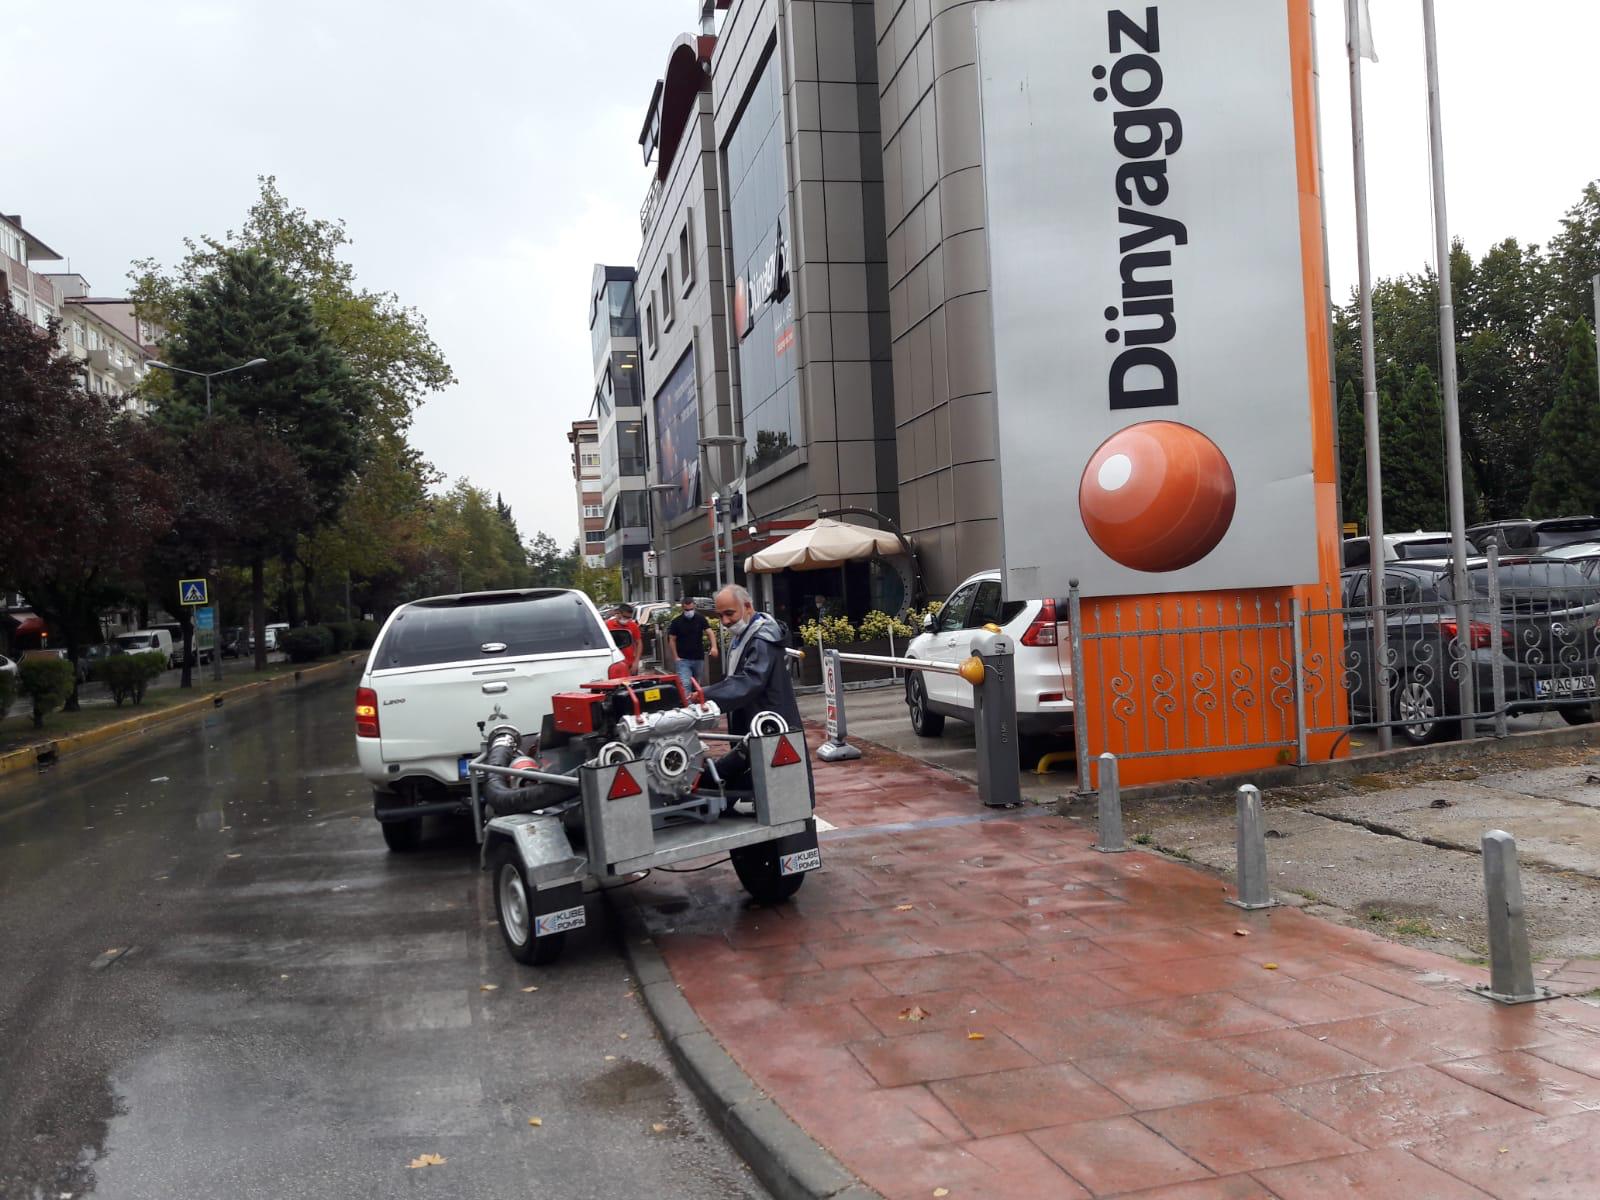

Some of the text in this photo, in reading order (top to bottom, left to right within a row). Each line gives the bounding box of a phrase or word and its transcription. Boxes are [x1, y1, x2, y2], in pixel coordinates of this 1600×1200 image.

[1091, 6, 1188, 411] Dünyagöz
[383, 697, 406, 706] L200
[797, 849, 818, 862] KUBE
[798, 859, 820, 870] POMPA
[556, 907, 585, 921] KUBE
